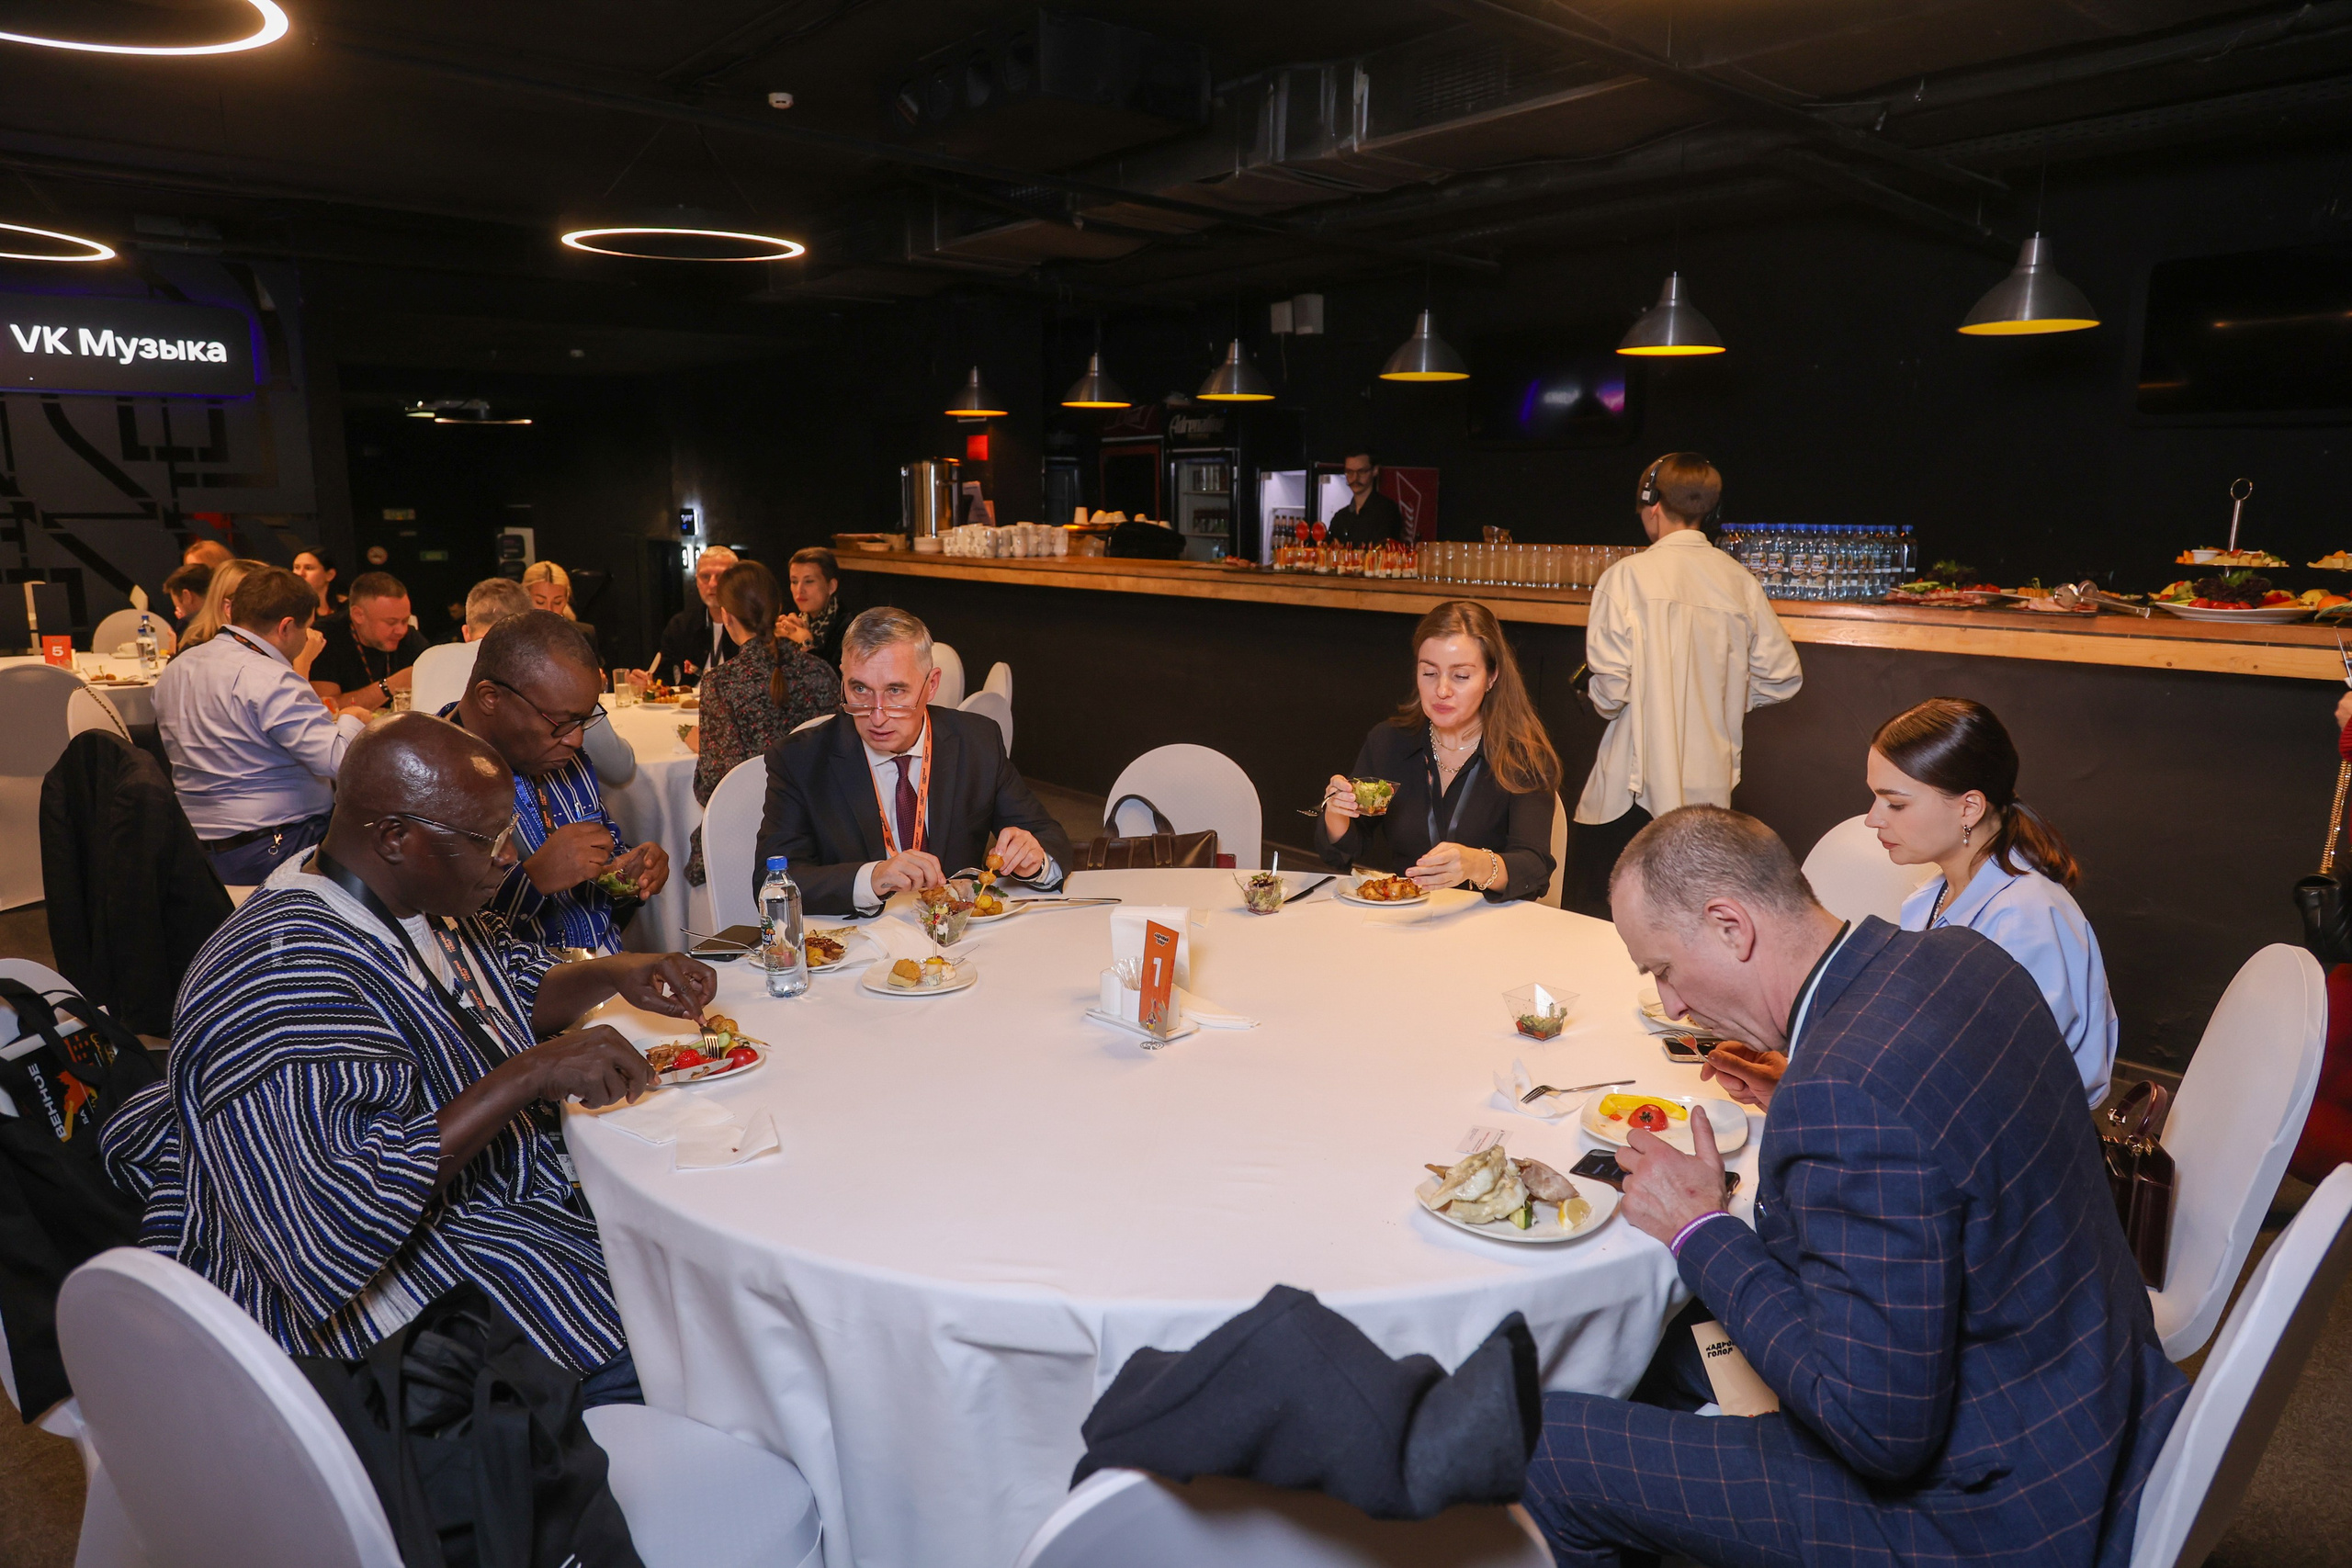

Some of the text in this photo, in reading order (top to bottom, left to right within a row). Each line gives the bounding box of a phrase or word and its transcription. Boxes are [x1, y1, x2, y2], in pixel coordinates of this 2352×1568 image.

[9, 323, 228, 365] VK Музыка
[51, 646, 64, 657] 5
[1153, 957, 1162, 987] 1
[28, 1063, 67, 1139] ВЕННОЕ
